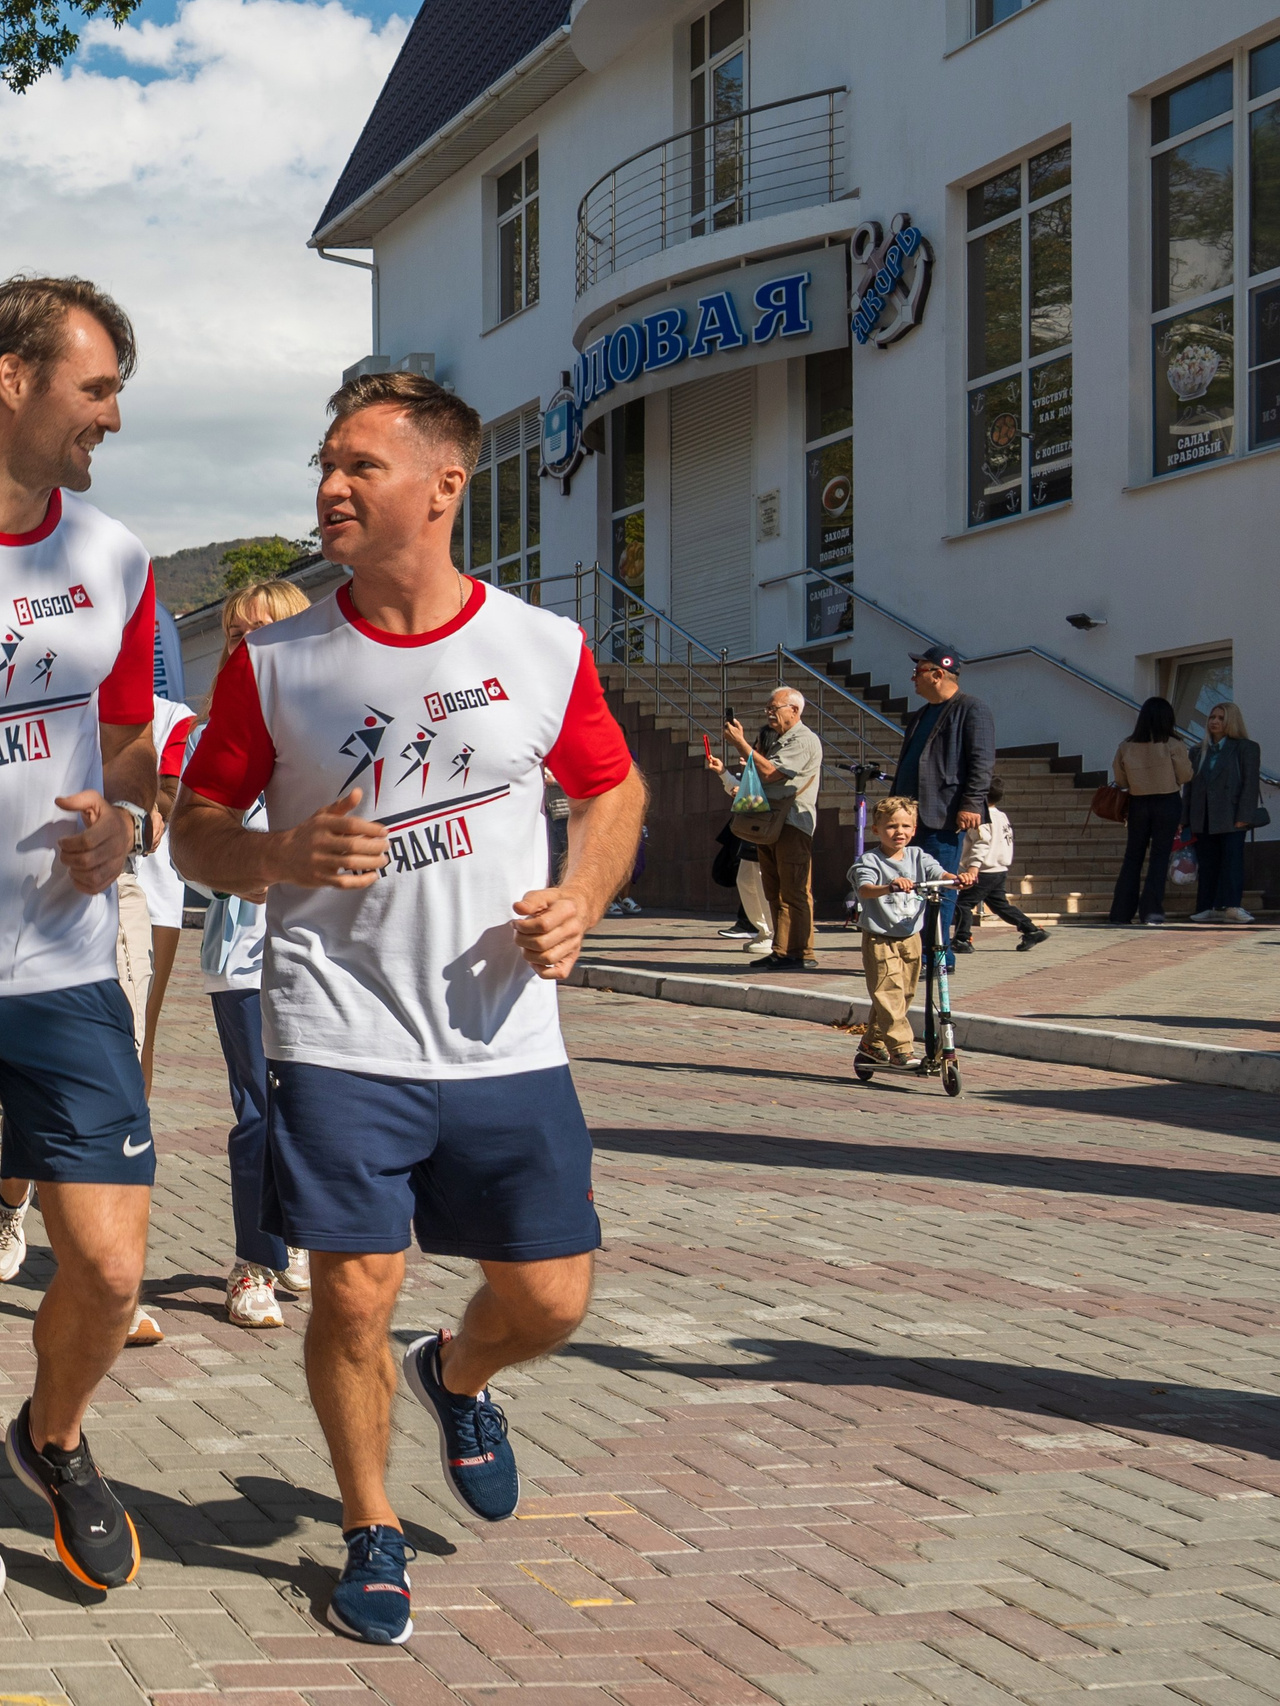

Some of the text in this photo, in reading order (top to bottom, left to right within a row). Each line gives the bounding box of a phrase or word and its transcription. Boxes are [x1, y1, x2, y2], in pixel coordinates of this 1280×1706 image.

[851, 226, 922, 345] ЯКОРЬ
[574, 272, 812, 411] ОЛОВАЯ
[1039, 409, 1055, 424] КАК
[1167, 438, 1222, 467] КРАБОВЫЙ
[1177, 430, 1211, 450] САЛАТ
[824, 527, 850, 543] ЗАХОДИ
[13, 594, 74, 626] BOSCO
[423, 688, 489, 723] BOSCO
